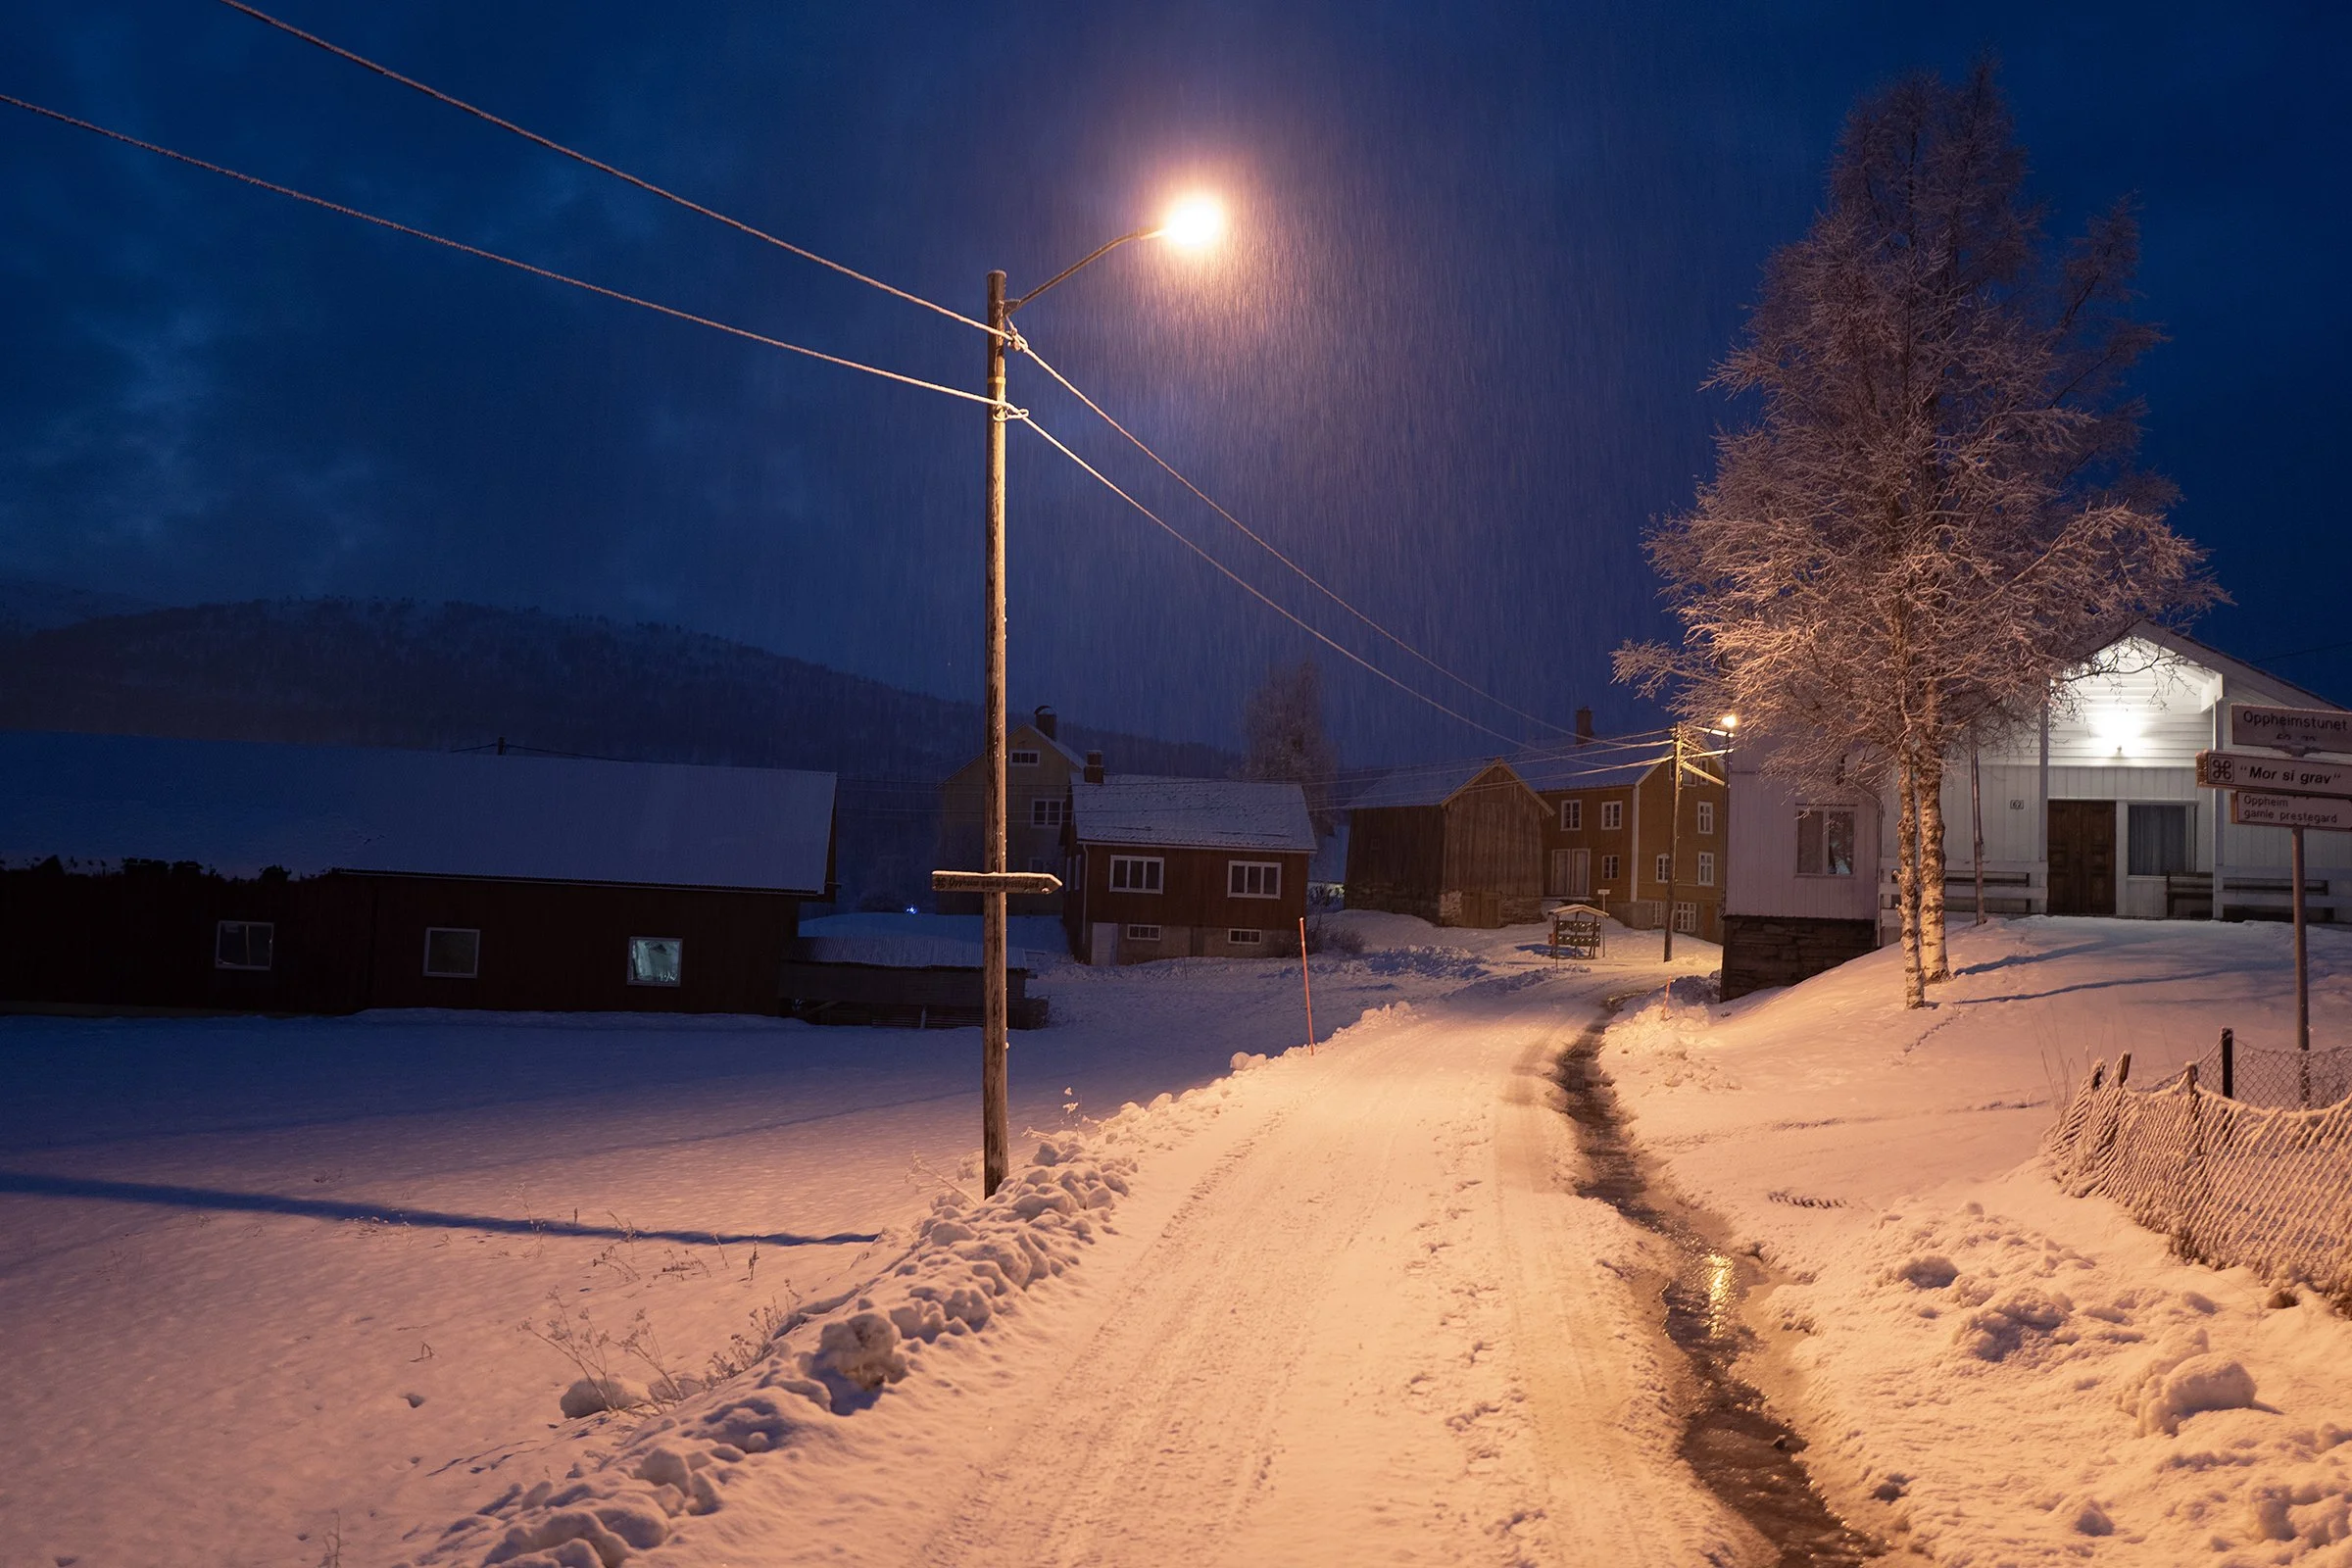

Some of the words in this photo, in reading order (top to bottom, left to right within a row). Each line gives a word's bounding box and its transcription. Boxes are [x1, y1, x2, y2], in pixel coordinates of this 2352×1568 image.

[2243, 710, 2348, 730] Oppheimstunet
[2282, 769, 2295, 781] si
[2244, 795, 2288, 807] Oppheim
[2244, 809, 2275, 819] gamle
[2279, 811, 2337, 824] prestegard
